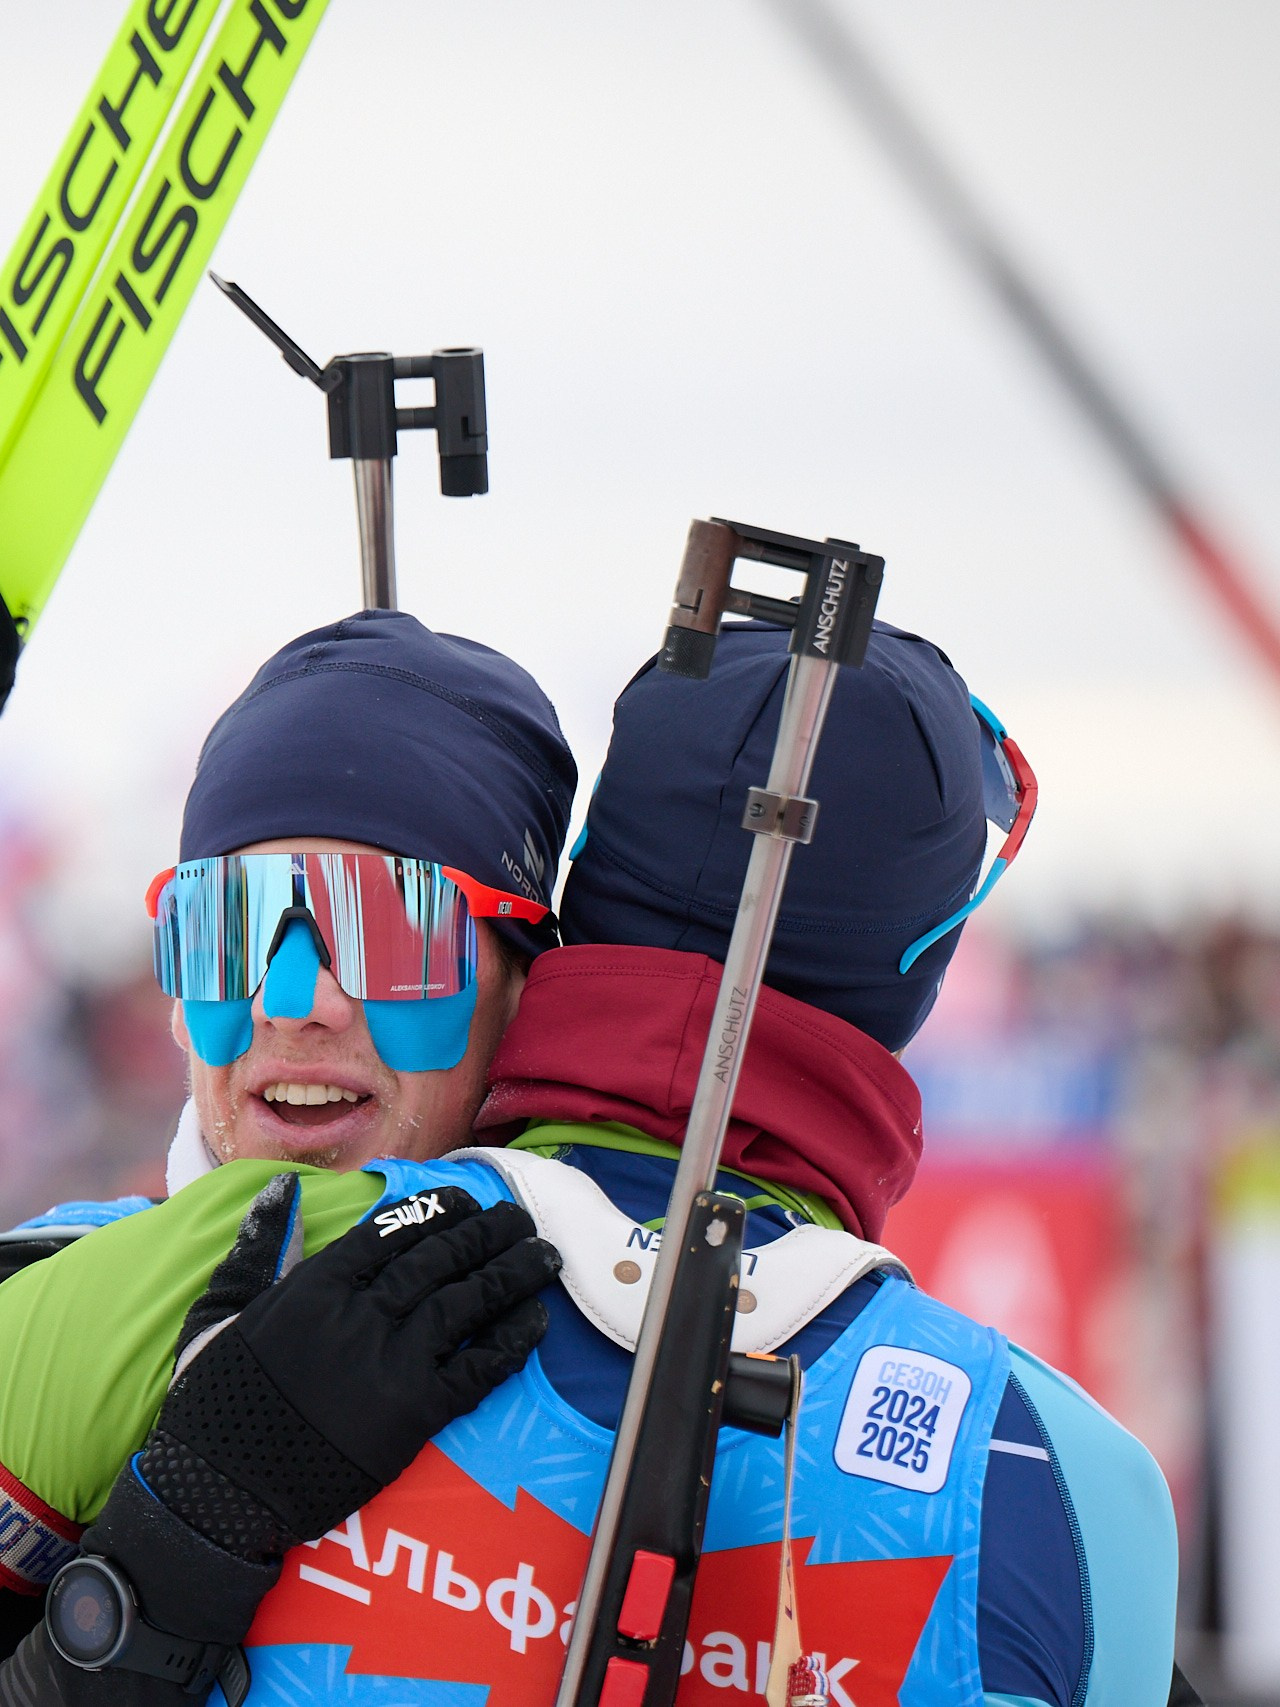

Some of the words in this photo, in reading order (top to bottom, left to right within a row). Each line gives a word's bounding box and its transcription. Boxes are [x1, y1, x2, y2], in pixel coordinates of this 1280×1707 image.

[812, 558, 848, 654] ANSCHÜTZ
[501, 850, 540, 904] NORD
[713, 986, 748, 1083] ANSCHÜTZ
[877, 1360, 953, 1406] СЕЗОН
[866, 1386, 941, 1439] 2024
[855, 1422, 932, 1474] 2025
